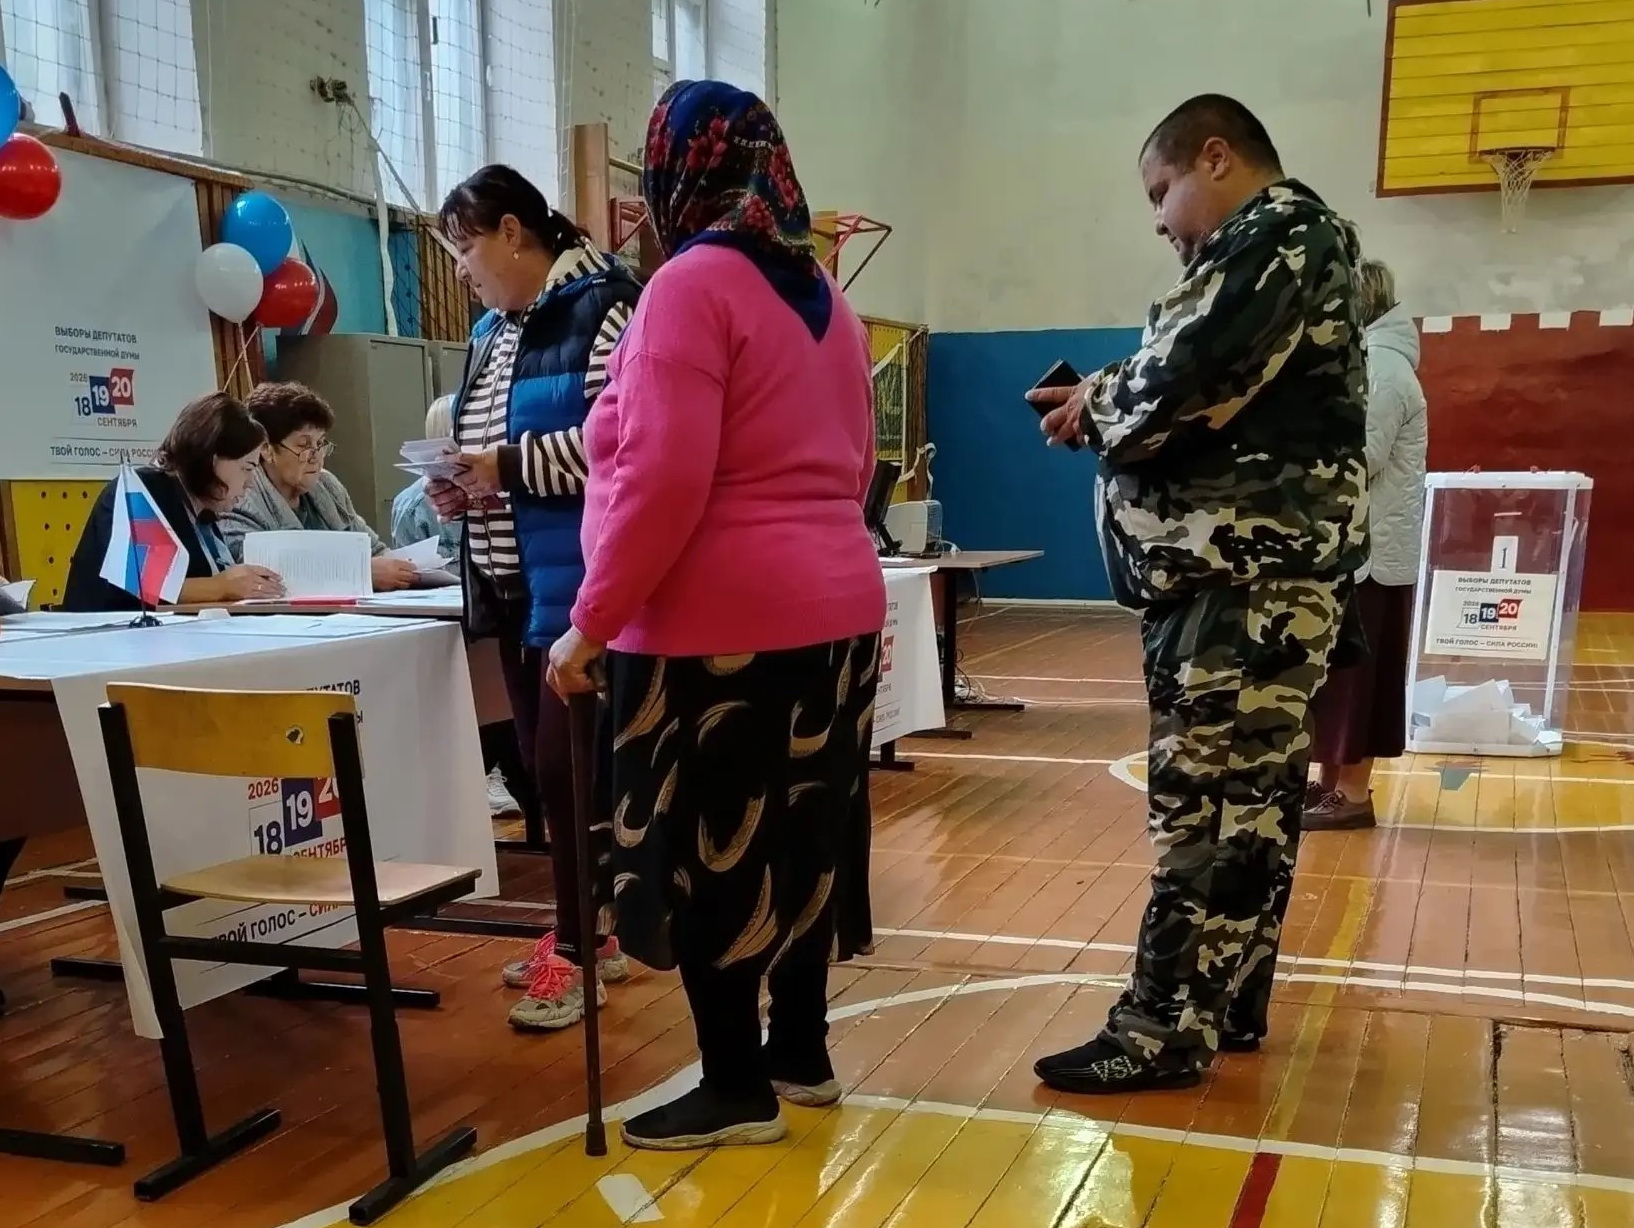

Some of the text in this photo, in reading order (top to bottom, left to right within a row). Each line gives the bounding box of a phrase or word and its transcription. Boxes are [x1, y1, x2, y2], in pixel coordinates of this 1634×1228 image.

[55, 326, 137, 344] ВЫБОРЫ ДЕПУТАТОВ
[55, 344, 119, 358] ГОСУДАРСТВЕННОЙ
[74, 376, 132, 416] 18 19 20
[97, 417, 138, 428] СЕНТЯБРЯ
[50, 444, 72, 456] ТВОЙ
[74, 446, 101, 457] ГОЛОС
[1500, 547, 1508, 569] 1
[1454, 586, 1513, 594] ГОСУДАРСТВЕННОЙ
[1464, 603, 1518, 624] 18 19 20
[248, 778, 279, 800] 2026
[254, 821, 283, 855] 18
[286, 791, 313, 831] 19
[250, 909, 295, 940] ГОЛОС
